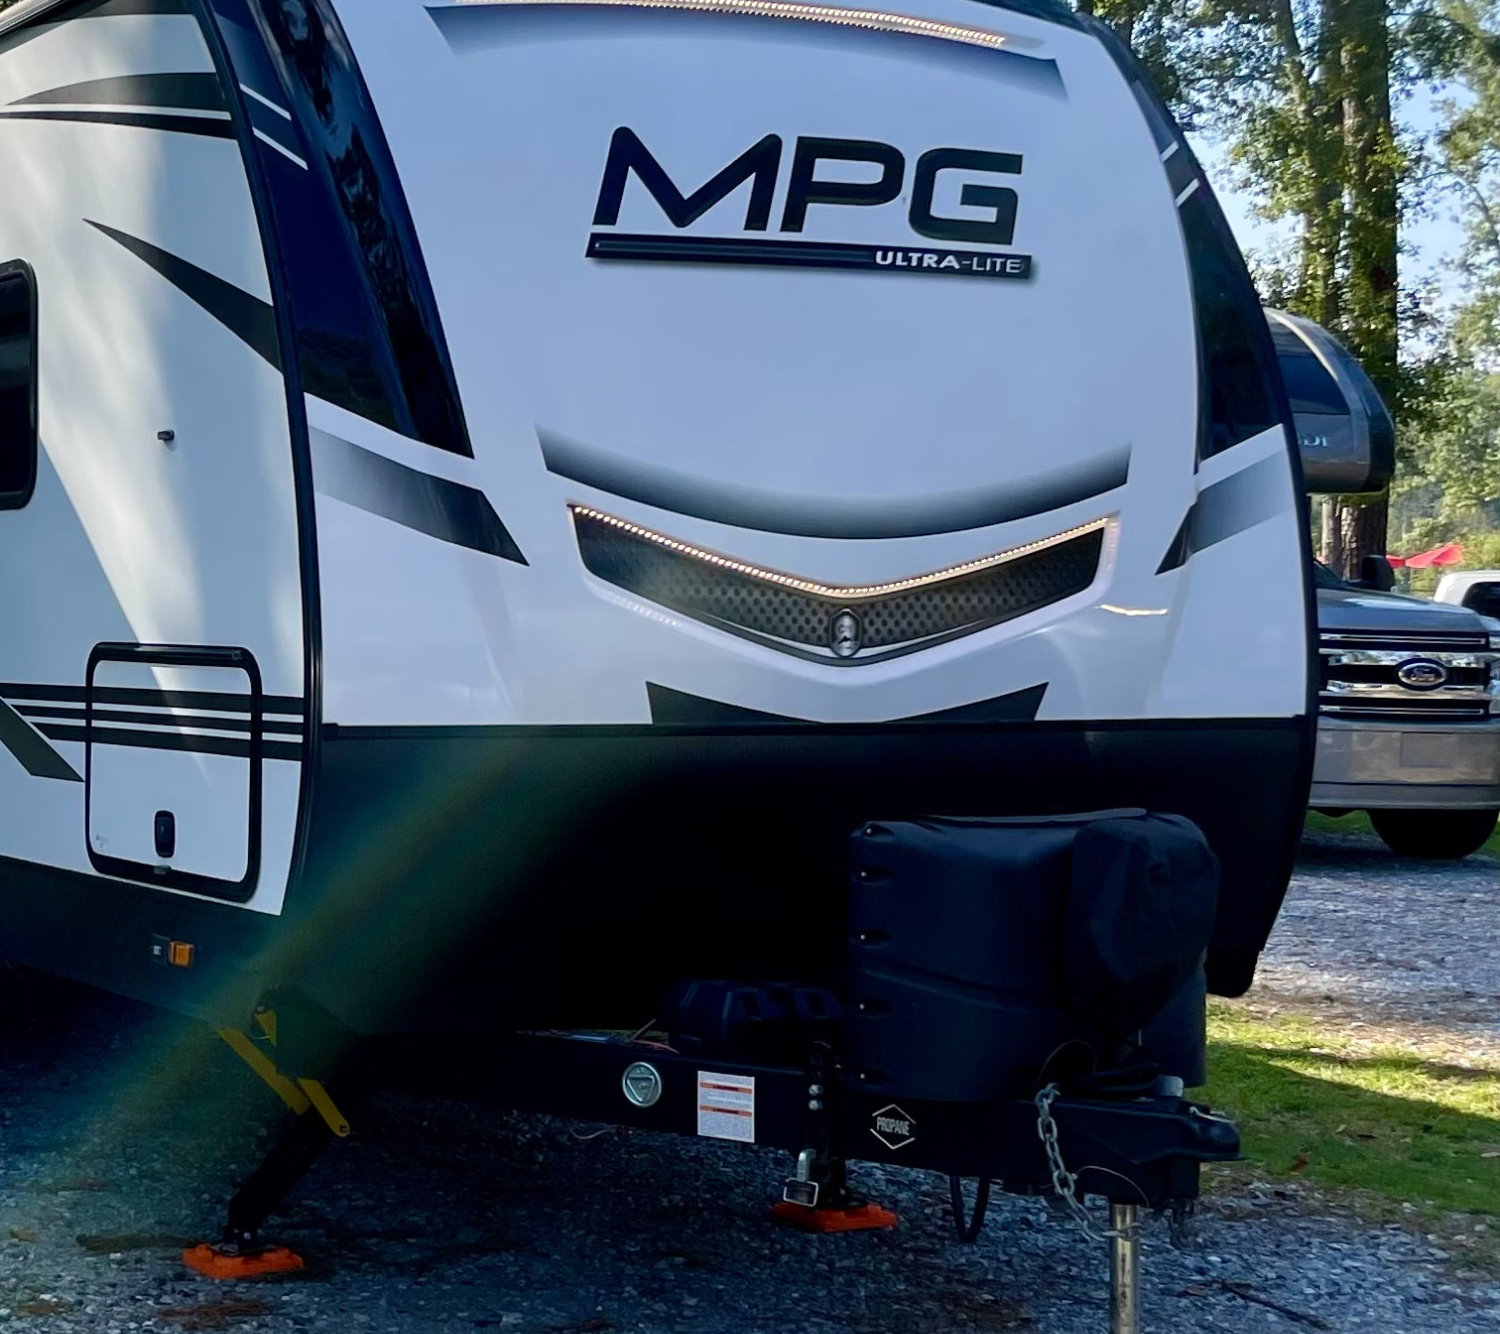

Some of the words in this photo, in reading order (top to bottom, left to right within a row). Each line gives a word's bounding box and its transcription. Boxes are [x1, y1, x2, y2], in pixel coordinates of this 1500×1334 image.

[592, 126, 1023, 245] MPG
[875, 250, 1023, 273] ULTRA-LITE
[1410, 667, 1436, 682] Ford
[876, 1116, 910, 1136] PROPANE
